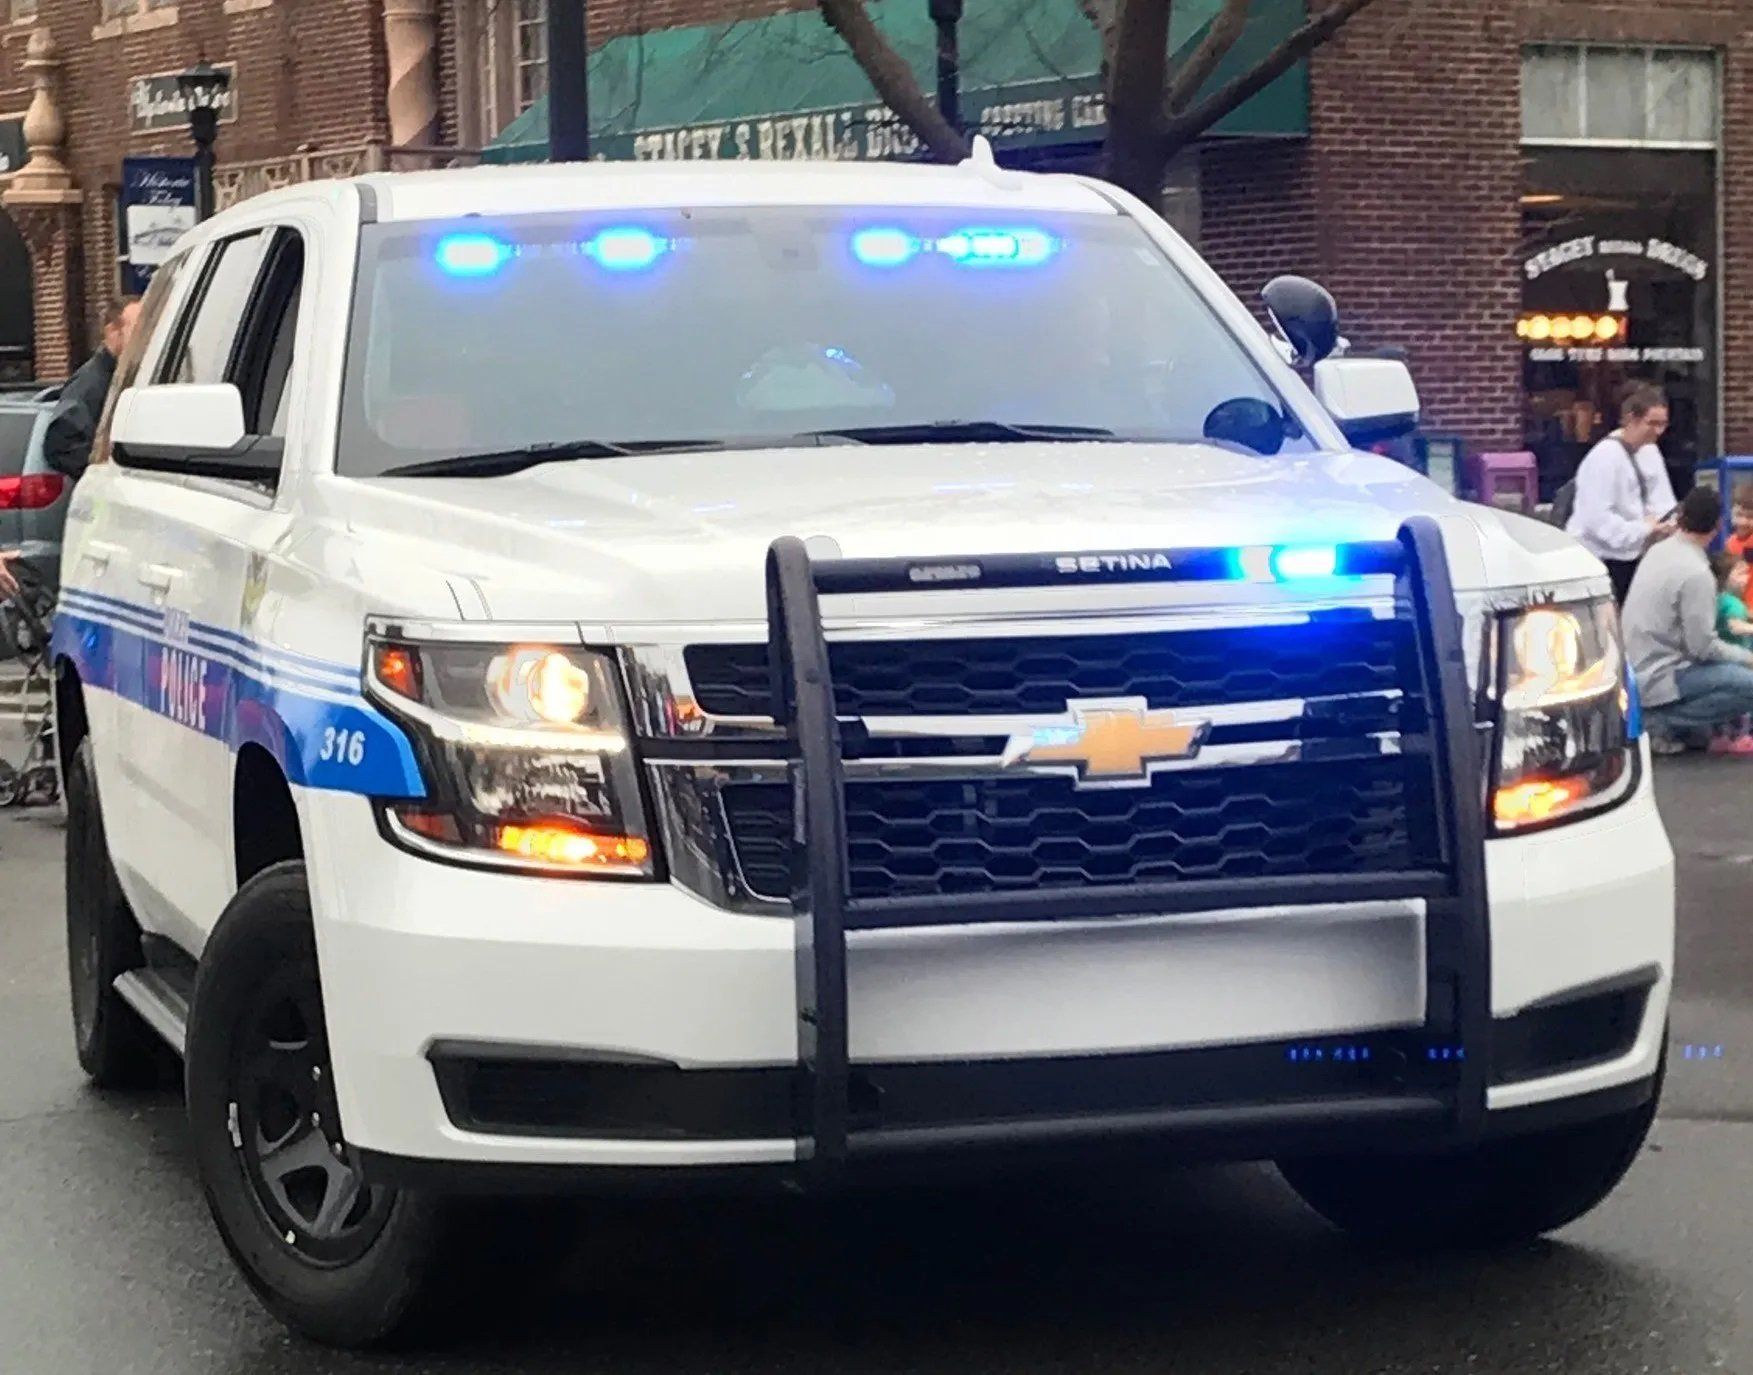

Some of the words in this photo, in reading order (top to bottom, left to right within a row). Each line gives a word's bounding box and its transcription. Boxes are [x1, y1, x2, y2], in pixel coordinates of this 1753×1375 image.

[757, 112, 858, 160] REXALL
[1055, 553, 1173, 574] SETINA
[160, 646, 208, 731] POLICE
[319, 726, 366, 766] 316
